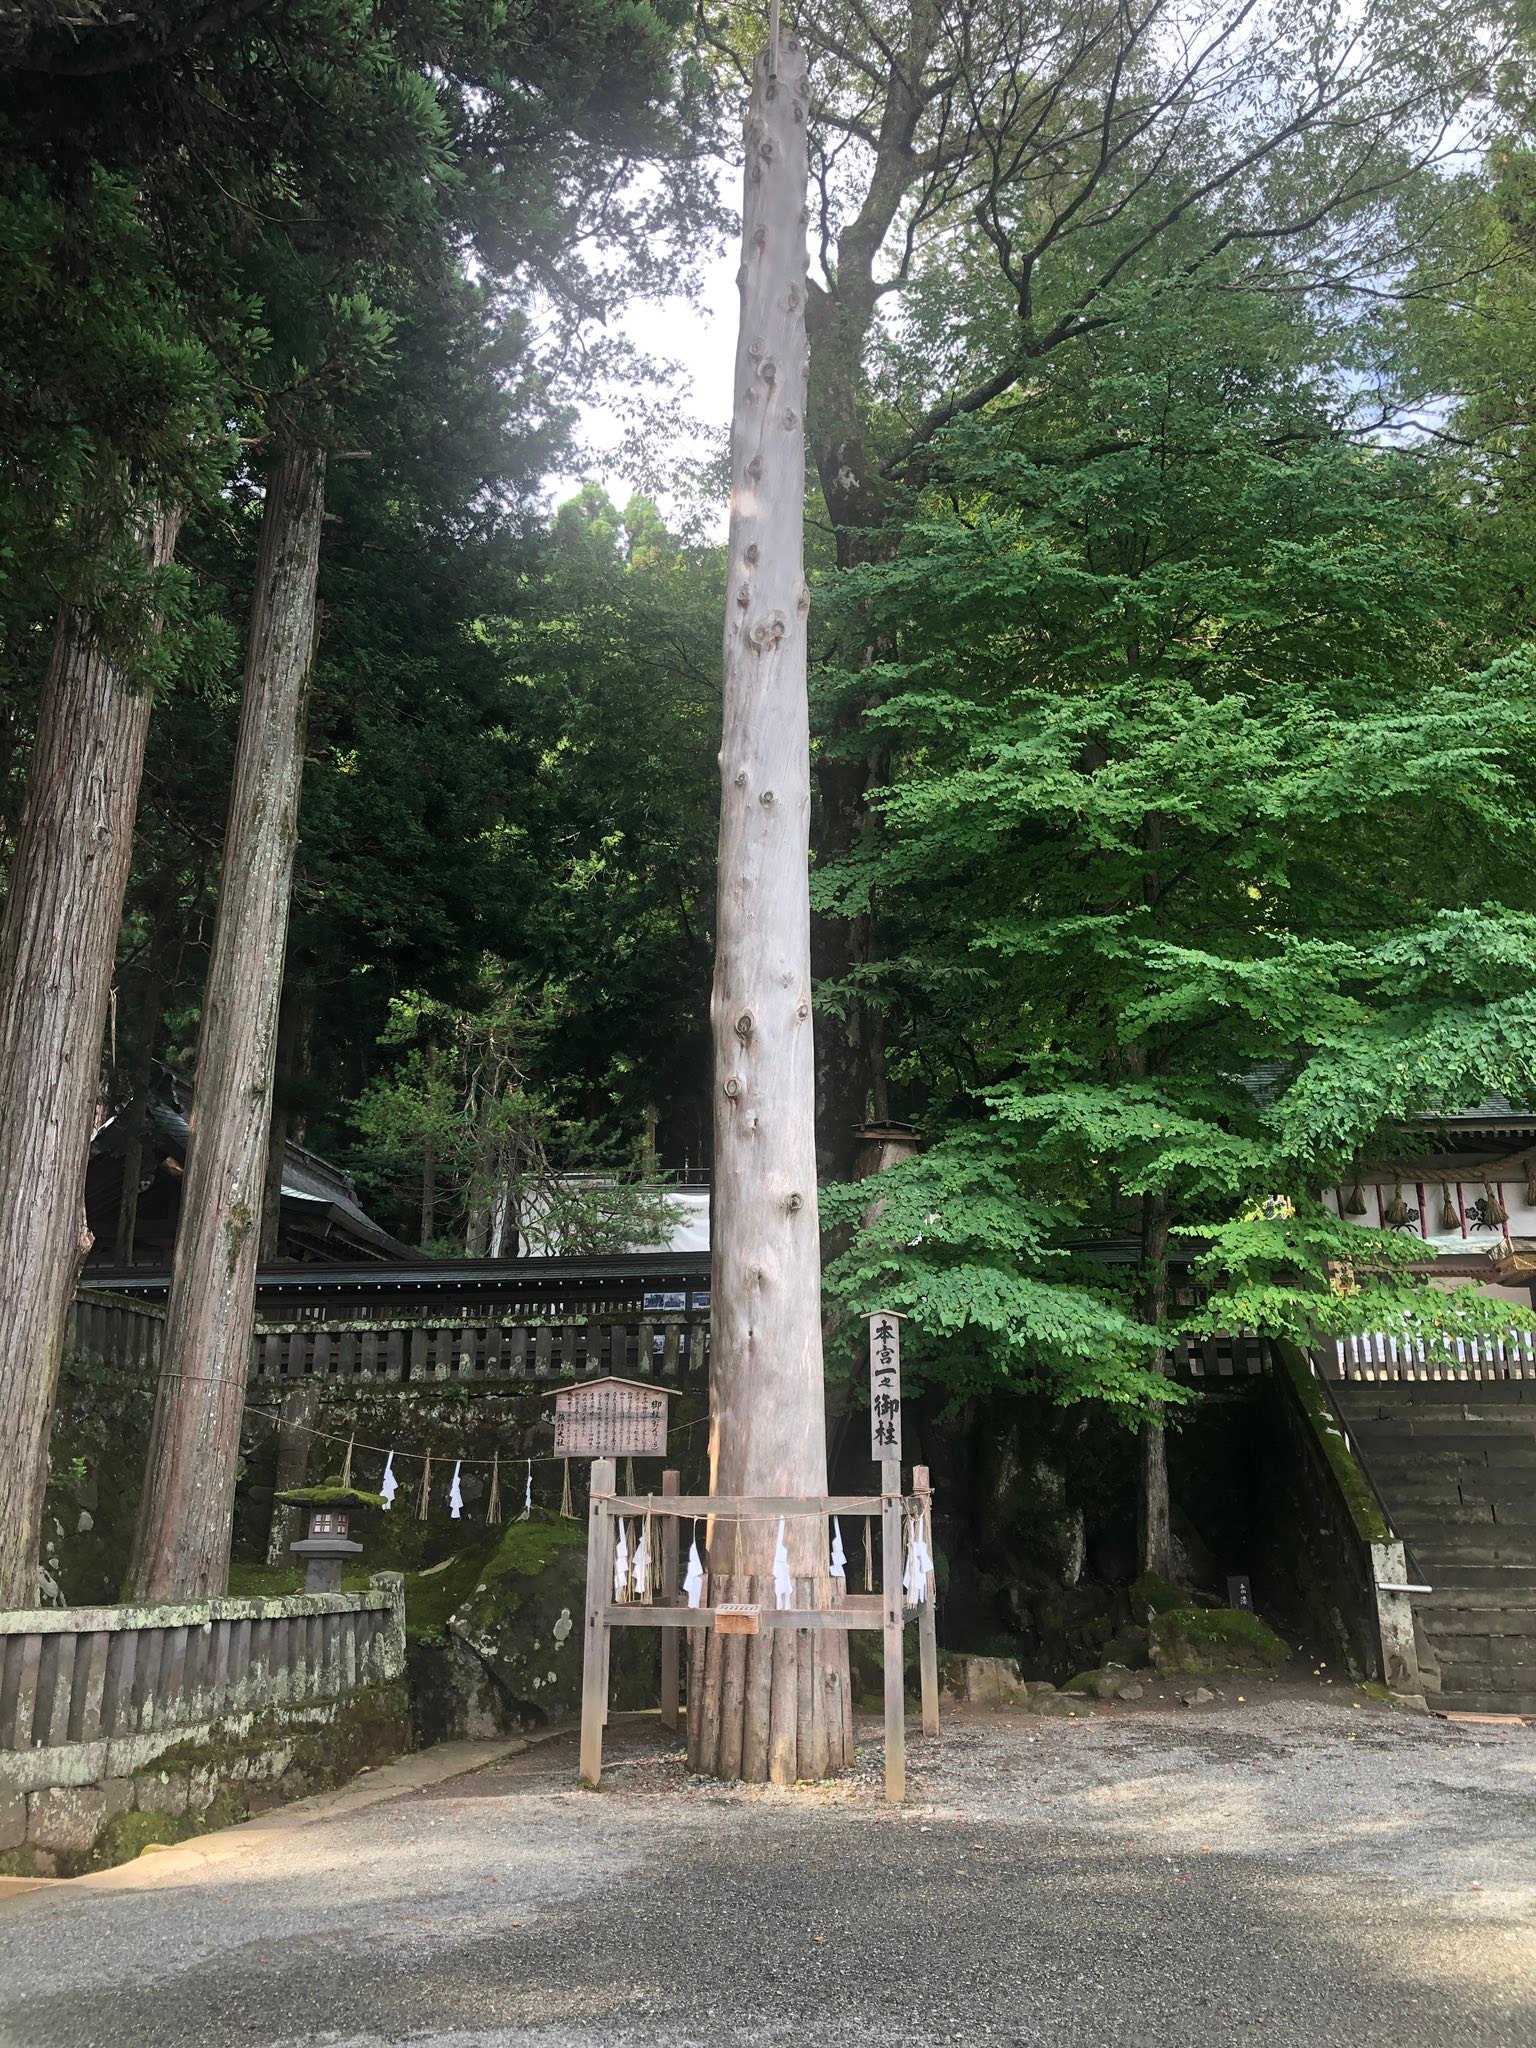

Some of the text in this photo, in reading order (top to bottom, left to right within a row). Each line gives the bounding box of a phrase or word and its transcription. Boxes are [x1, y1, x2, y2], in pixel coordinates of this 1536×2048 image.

[873, 1319, 899, 1446] 本宮一之御柱
